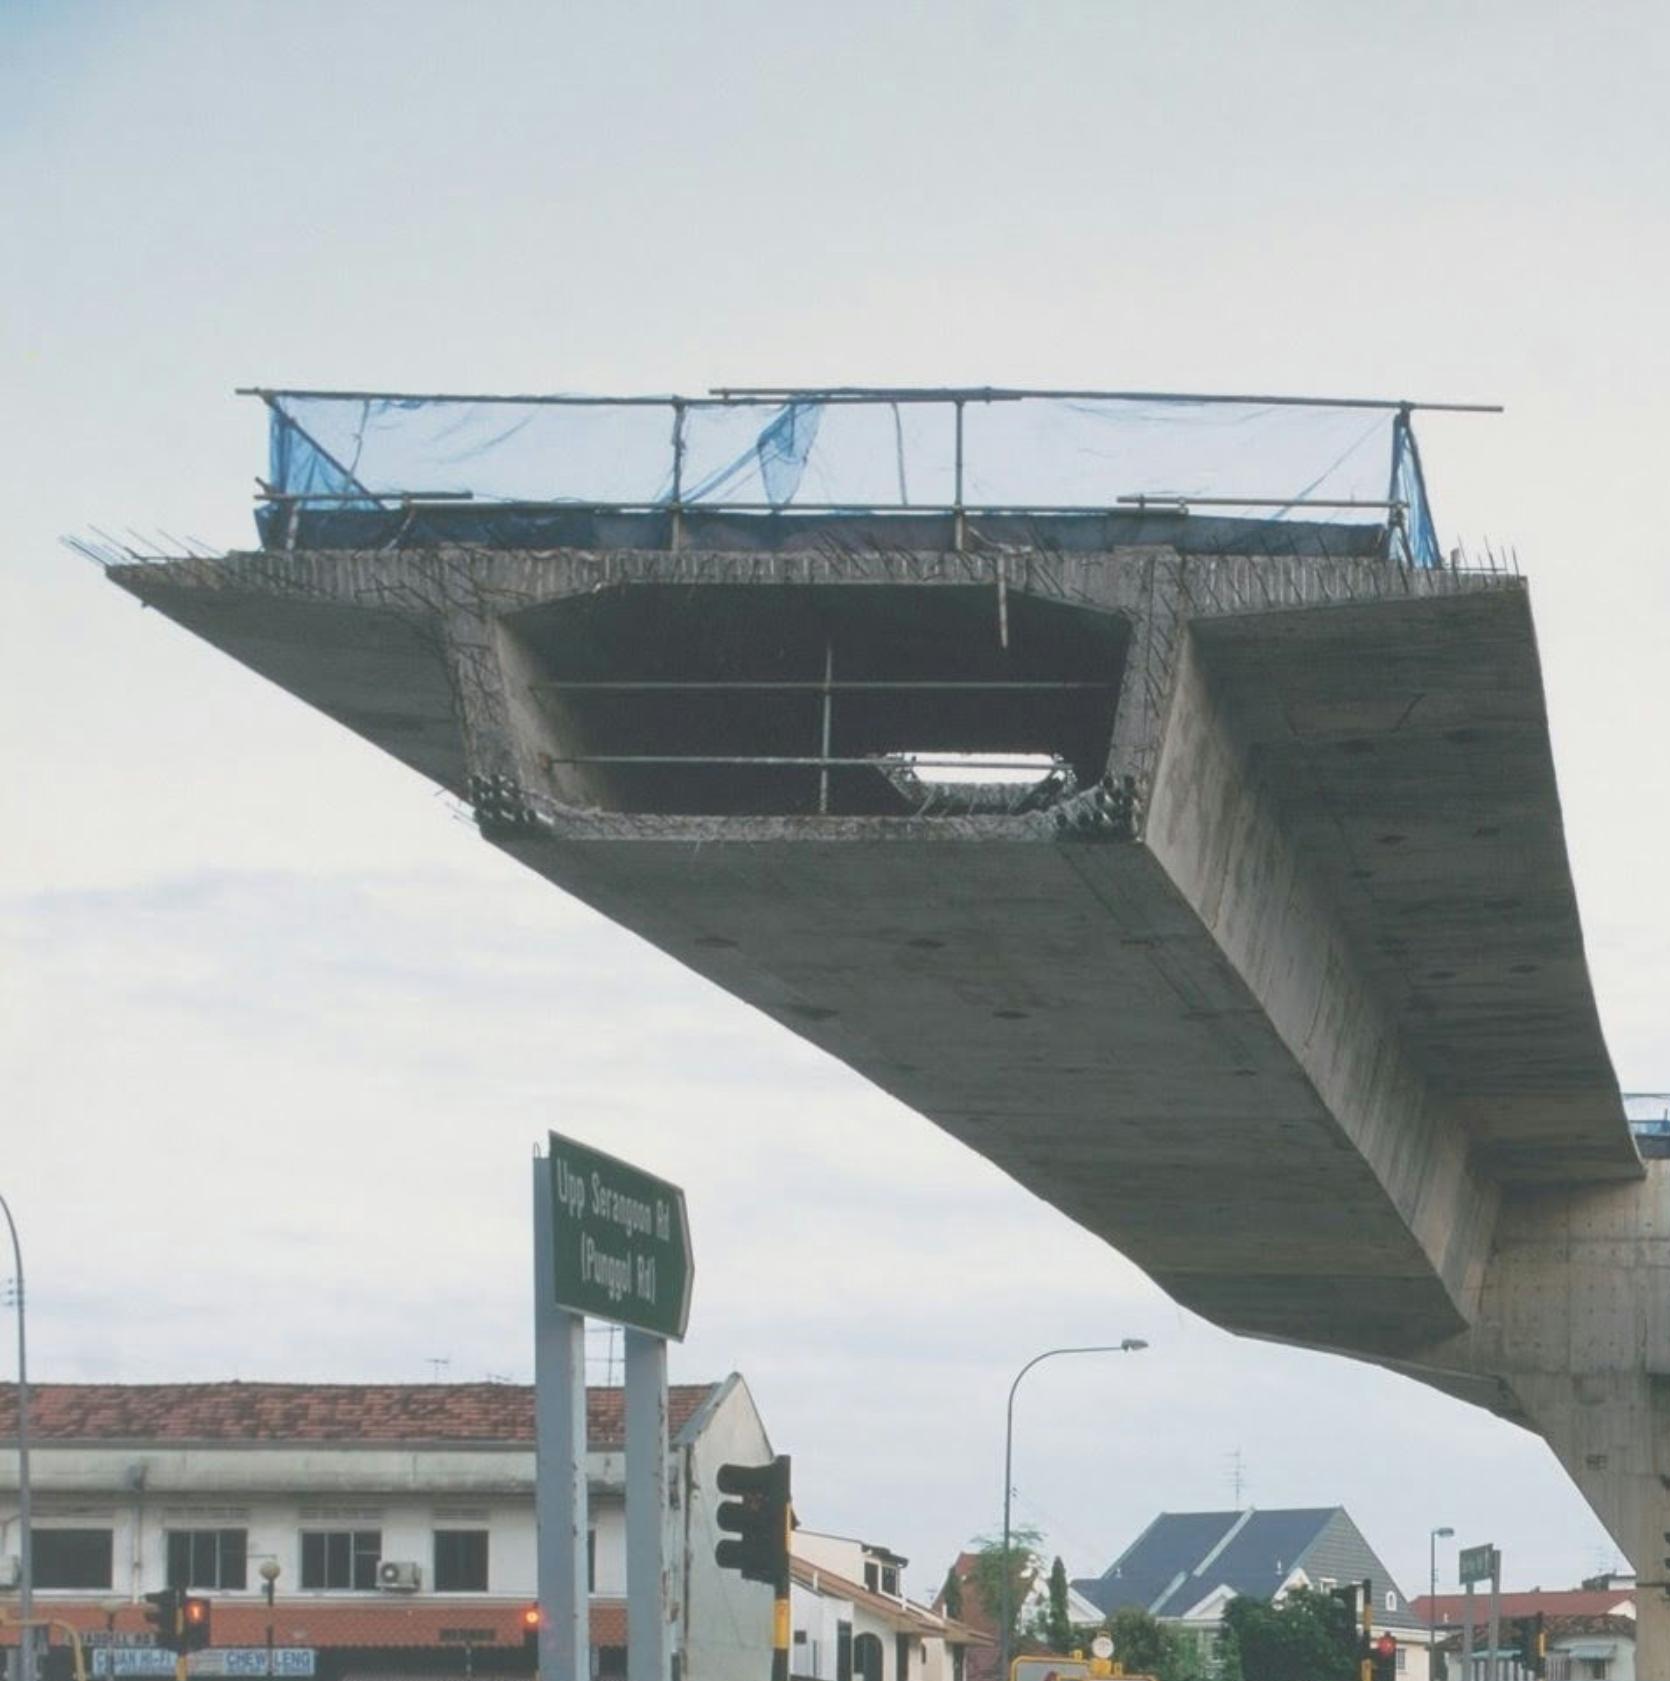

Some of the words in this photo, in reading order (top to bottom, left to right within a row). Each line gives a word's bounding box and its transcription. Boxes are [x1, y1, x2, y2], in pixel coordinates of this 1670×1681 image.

[557, 1158, 585, 1220] Upp
[592, 1171, 652, 1238] Serangoon
[656, 1199, 670, 1242] Rd
[582, 1231, 632, 1302] (Punggol
